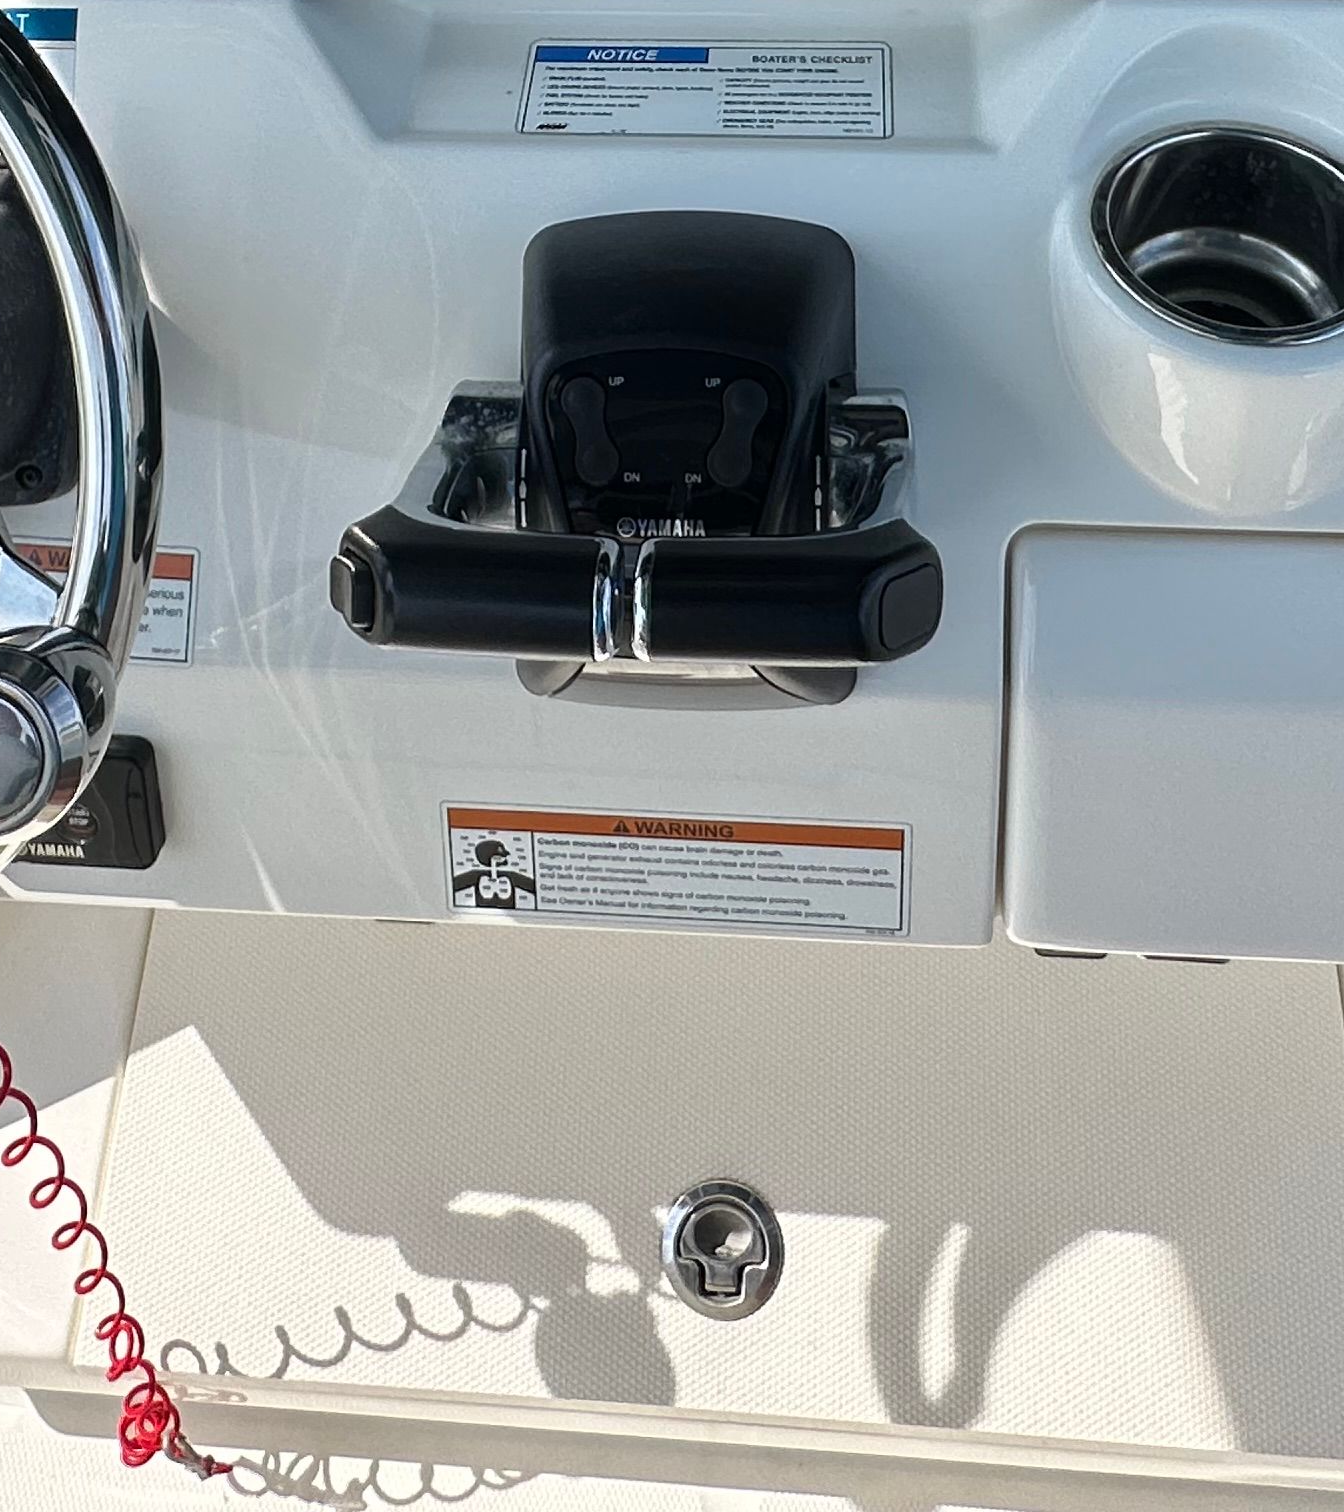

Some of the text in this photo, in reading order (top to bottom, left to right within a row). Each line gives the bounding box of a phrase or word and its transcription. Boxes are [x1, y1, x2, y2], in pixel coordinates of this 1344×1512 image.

[587, 49, 659, 61] NOTICE
[752, 55, 873, 64] BOATER'S CHECKLIST
[608, 376, 624, 386] UP
[705, 377, 721, 388] UP
[623, 472, 640, 482] DN
[685, 473, 702, 484] DN
[637, 519, 706, 538] YAMAHA
[634, 820, 735, 838] WARNING
[28, 843, 85, 858] YAMAHA
